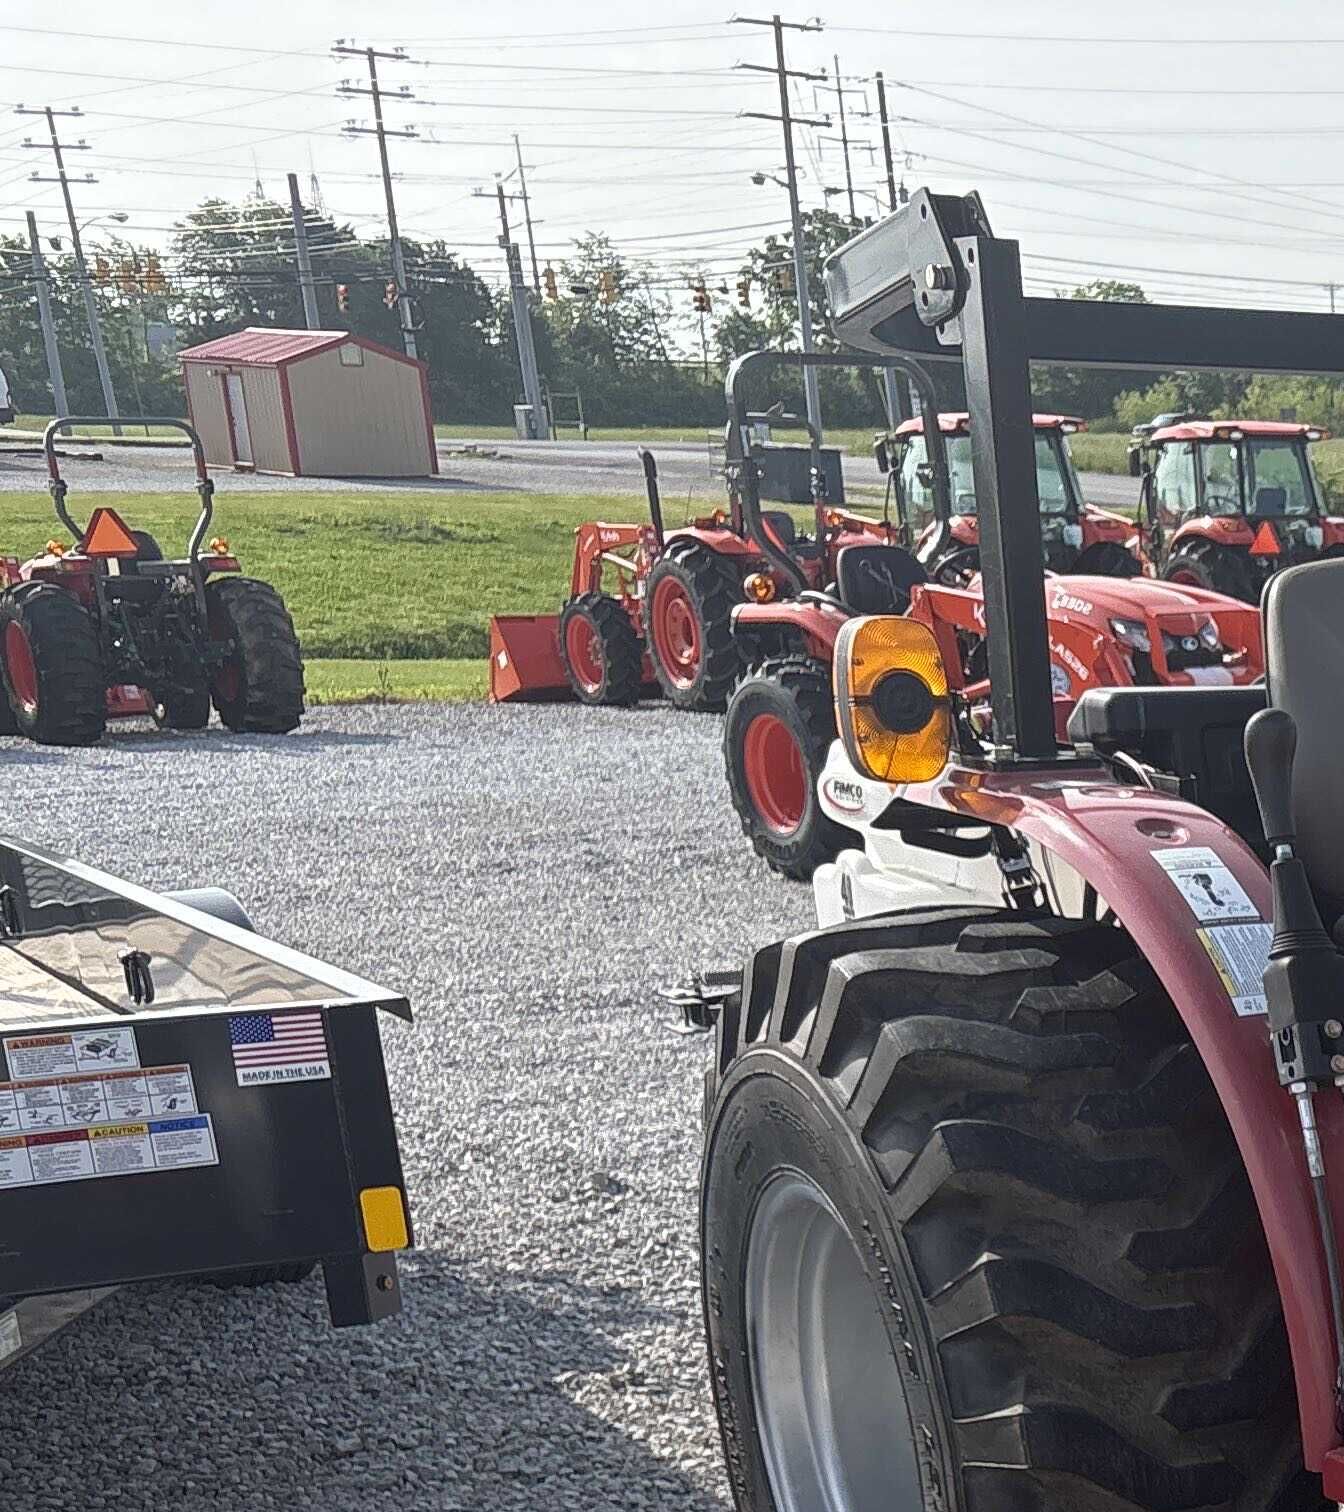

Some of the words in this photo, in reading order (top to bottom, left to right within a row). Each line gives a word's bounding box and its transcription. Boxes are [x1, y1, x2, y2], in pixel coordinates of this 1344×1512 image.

[242, 1070, 271, 1082] MADE
[305, 1065, 325, 1076] USA
[103, 1126, 144, 1137] CAUTION
